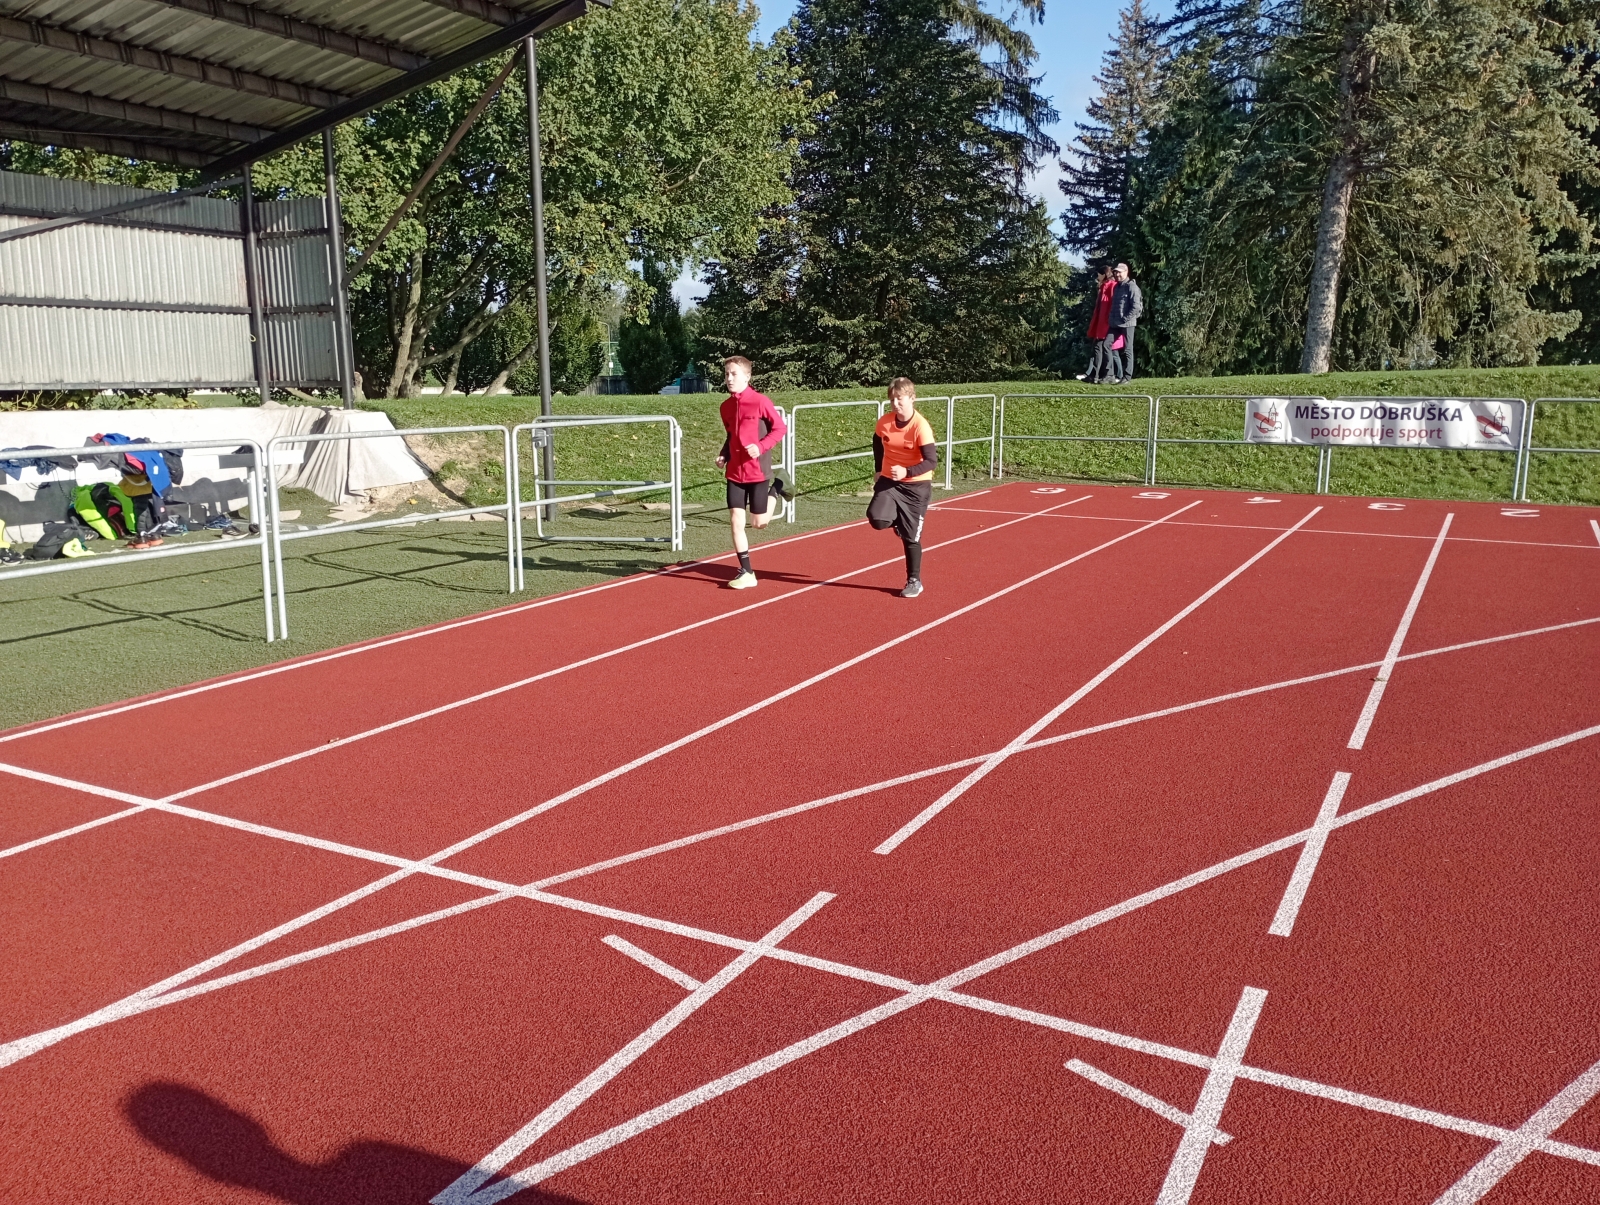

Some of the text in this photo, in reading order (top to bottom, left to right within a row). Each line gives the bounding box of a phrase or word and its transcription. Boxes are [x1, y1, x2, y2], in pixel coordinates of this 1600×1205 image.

[1295, 403, 1463, 422] MĚSTO DOBRUŠKA
[1311, 424, 1443, 442] podporuje sport
[1030, 487, 1067, 495] 6
[1131, 491, 1172, 500] 5
[1243, 496, 1282, 504] 4
[1367, 502, 1407, 511] 3
[1500, 508, 1541, 518] 2
